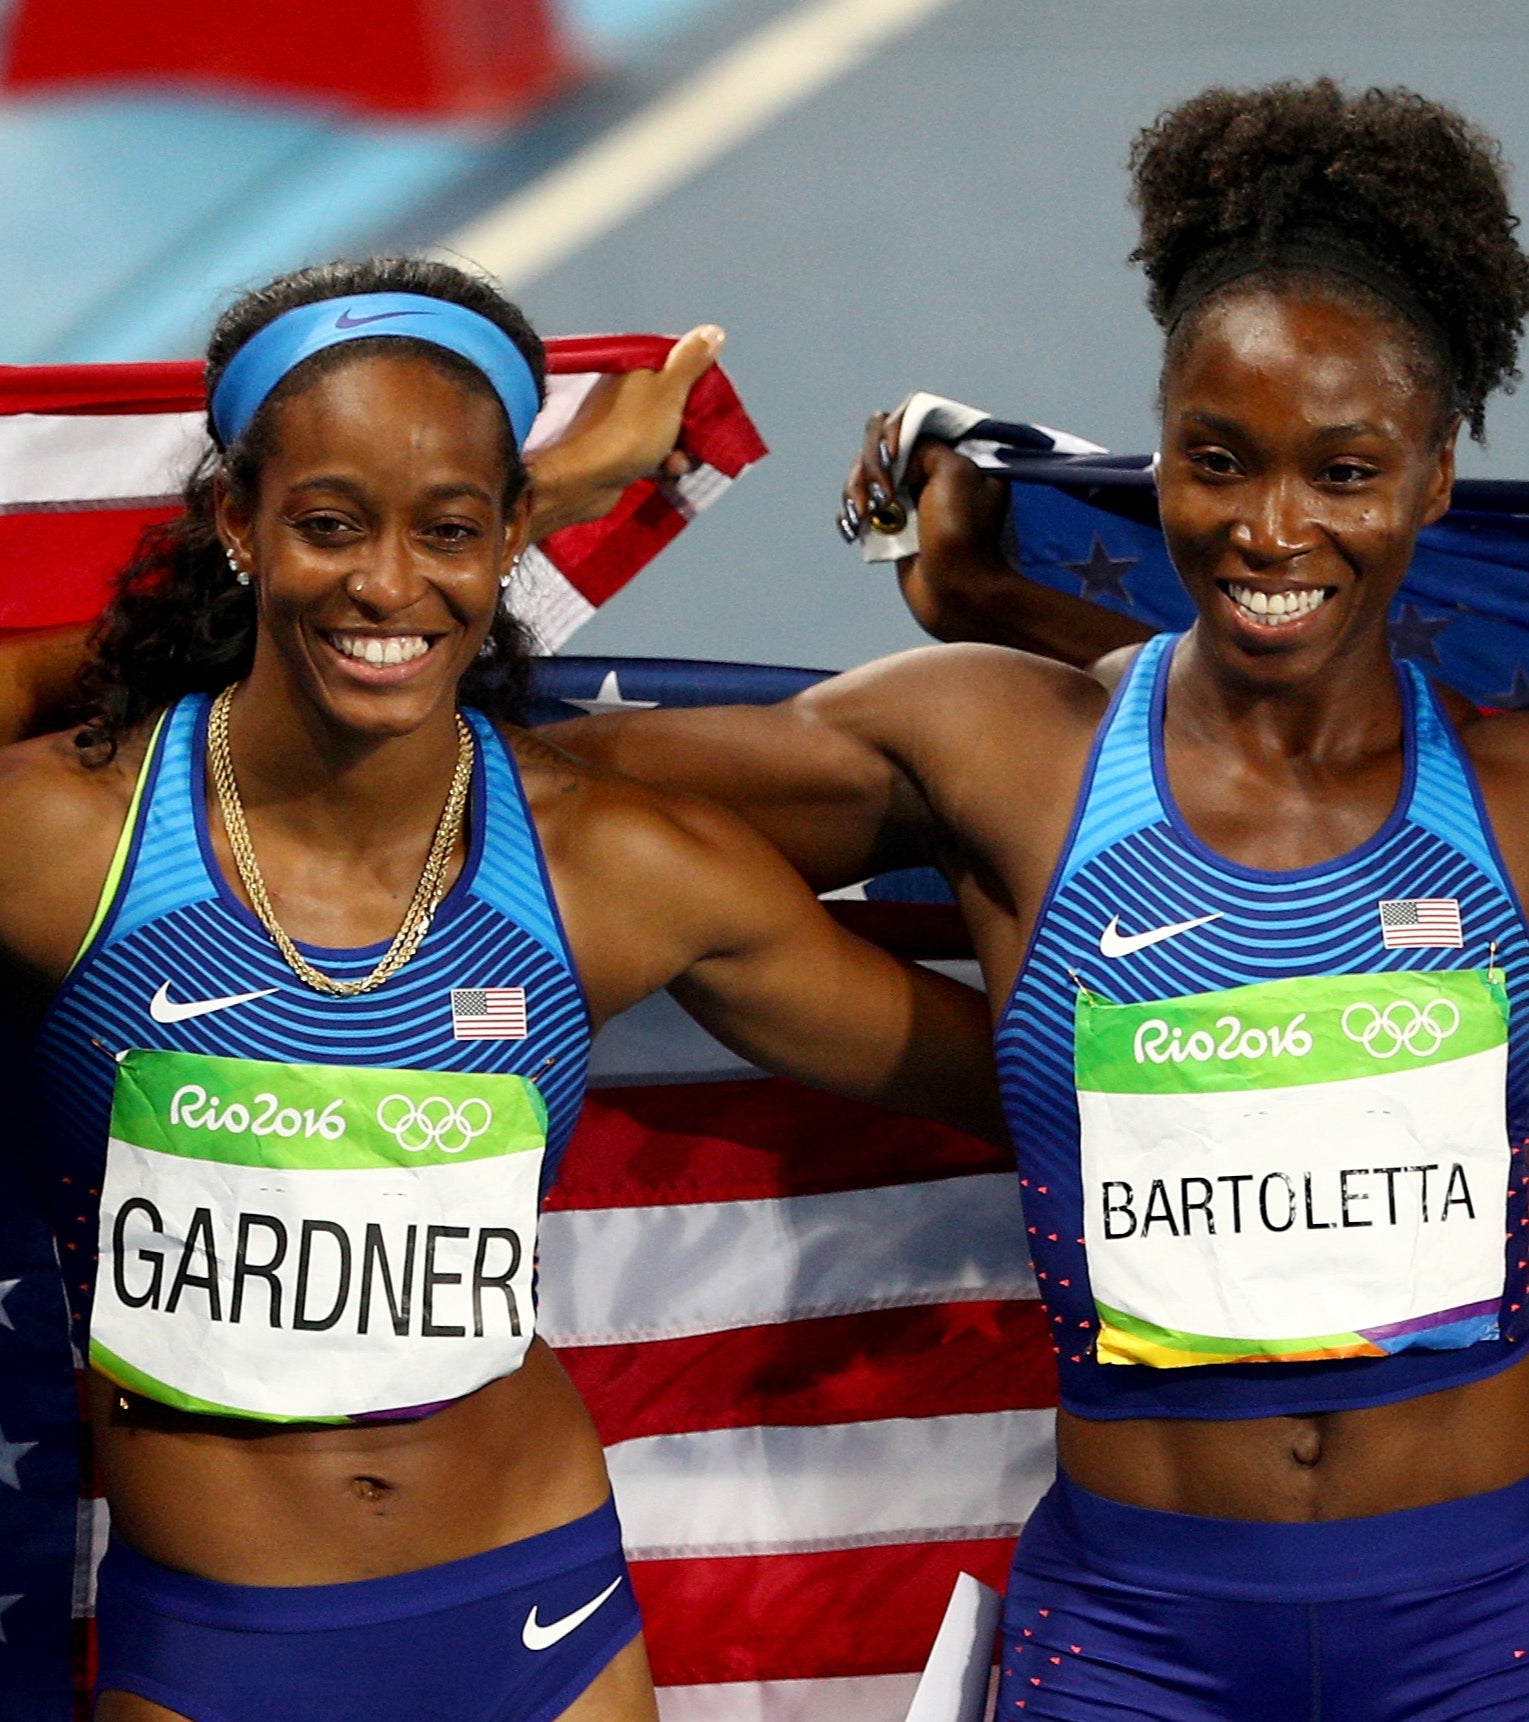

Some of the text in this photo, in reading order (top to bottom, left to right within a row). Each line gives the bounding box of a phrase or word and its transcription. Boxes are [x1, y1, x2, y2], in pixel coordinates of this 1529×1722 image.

[1132, 1012, 1314, 1065] Rio2016
[170, 1084, 347, 1140] Rio2016
[1101, 1162, 1477, 1241] BARTOLETTA
[111, 1196, 523, 1338] GARDNER
